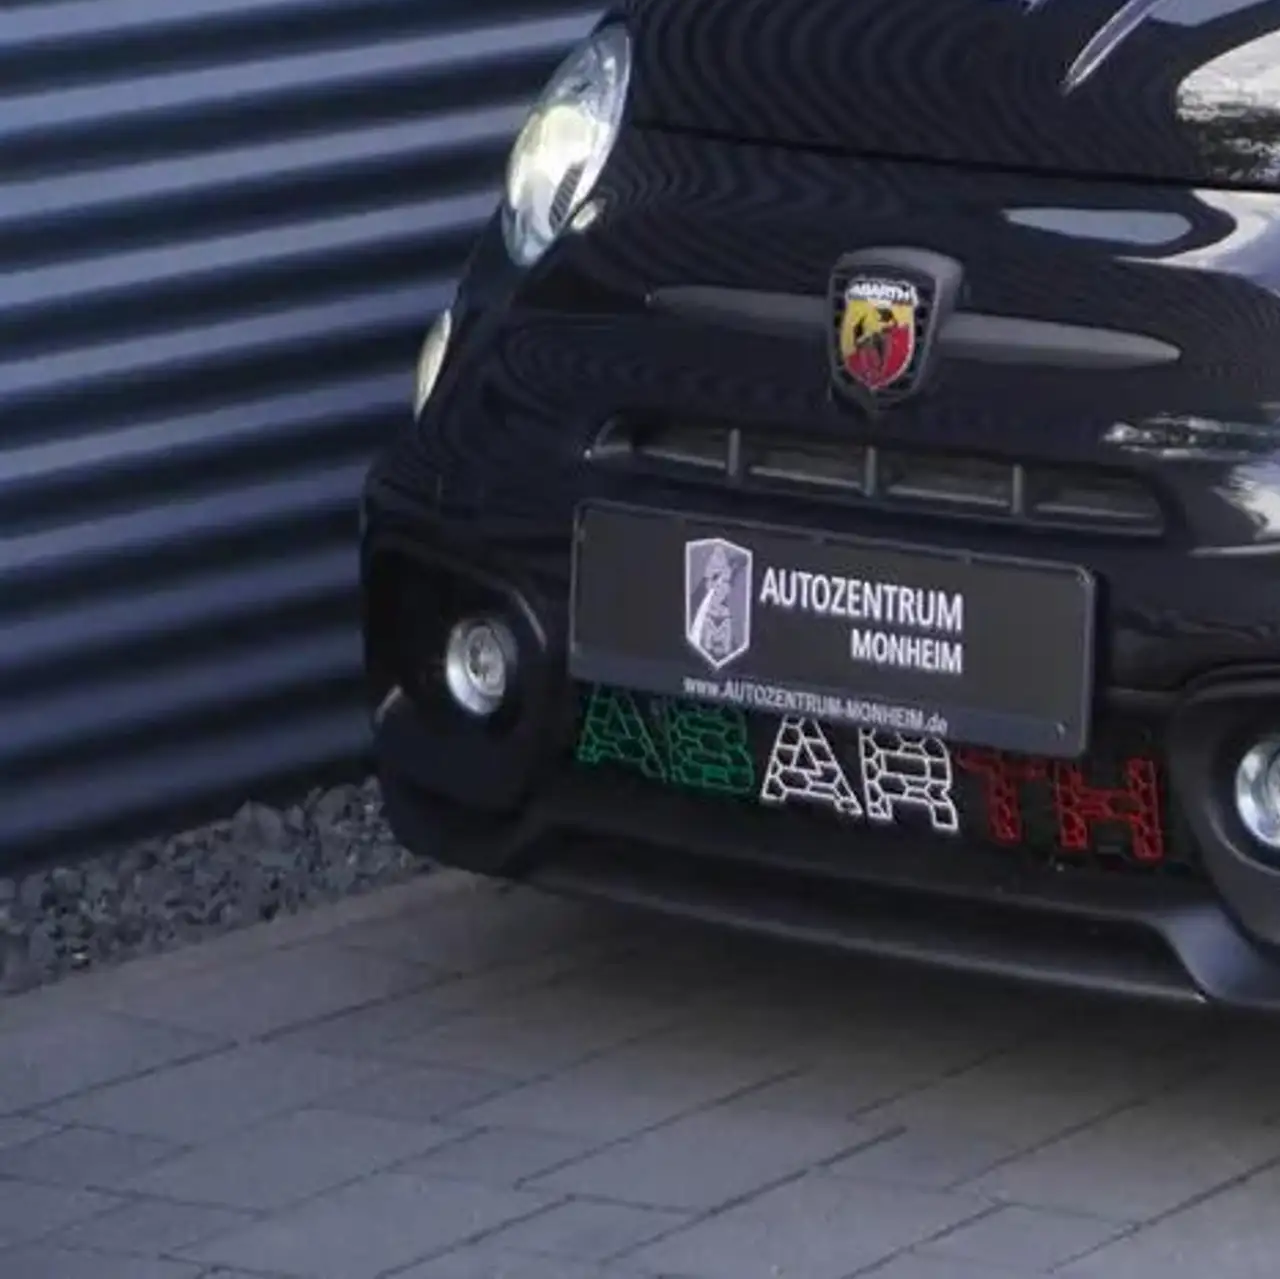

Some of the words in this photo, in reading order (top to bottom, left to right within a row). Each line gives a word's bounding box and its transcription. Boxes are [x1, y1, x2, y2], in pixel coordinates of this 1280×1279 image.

[760, 566, 964, 633] AUTOZENTRUM
[851, 628, 964, 675] MONHEIM
[682, 677, 950, 737] www.AUTOZENTRUM-MONHEIM.de
[573, 688, 1166, 862] ABARTH
